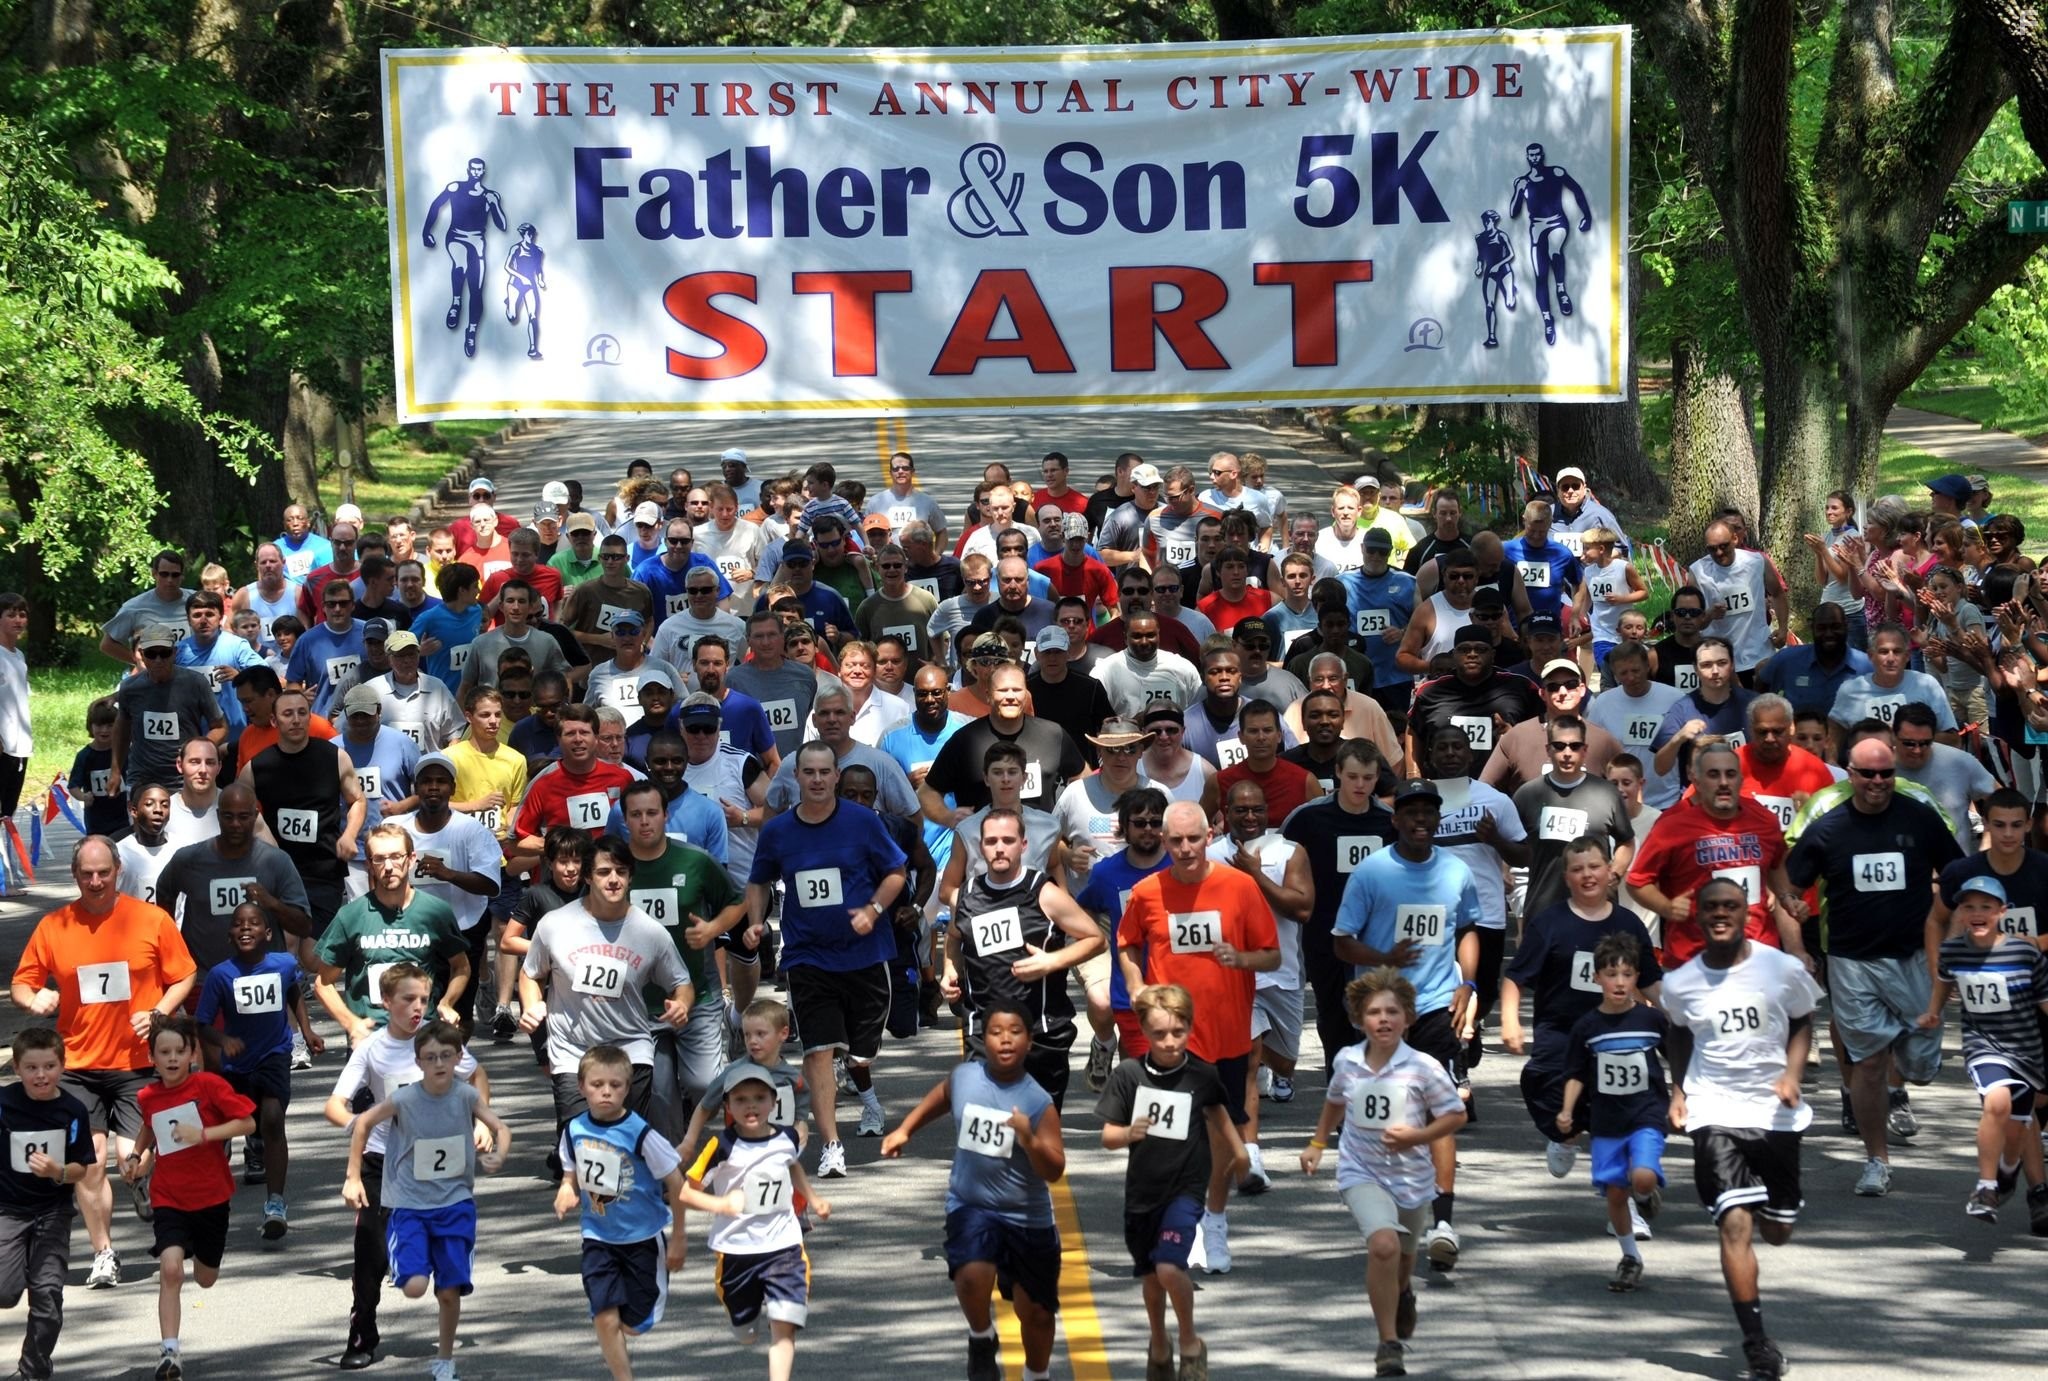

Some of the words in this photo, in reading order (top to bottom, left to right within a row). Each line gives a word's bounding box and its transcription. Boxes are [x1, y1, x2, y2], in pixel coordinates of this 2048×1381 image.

[490, 82, 616, 116] THE
[651, 81, 839, 117] FIRST
[869, 79, 1134, 116] ANNUAL
[1167, 62, 1524, 111] CITY-WIDE
[573, 145, 931, 241] Father
[947, 142, 1028, 238] &
[1043, 141, 1247, 234] Son
[1294, 130, 1451, 229] 5K
[2011, 206, 2025, 228] N
[662, 259, 1374, 380] START
[893, 511, 913, 523] 442
[1170, 546, 1192, 561] 597
[1522, 568, 1546, 583] 254
[1724, 592, 1749, 612] 175
[1360, 616, 1386, 633] 253
[147, 720, 174, 736] 242
[765, 708, 793, 728] 182
[1628, 721, 1657, 741] 467
[579, 802, 603, 824] 76
[281, 816, 311, 838] 264
[1696, 843, 1762, 865] GIANTS
[1861, 861, 1896, 883] 463
[806, 879, 830, 901] 39
[642, 898, 666, 920] 78
[979, 919, 1011, 949] 207
[1175, 922, 1213, 947] 261
[1402, 913, 1438, 937] 460
[360, 933, 432, 950] MASADA
[98, 972, 110, 996] 7
[581, 964, 619, 990] 120
[240, 983, 277, 1008] 504
[1966, 982, 2001, 1005] 473
[1718, 1005, 1760, 1033] 258
[1604, 1063, 1641, 1088] 533
[1147, 1101, 1174, 1129] 84
[1364, 1094, 1391, 1121] 83
[967, 1116, 1005, 1148] 435
[432, 1148, 446, 1173] 2
[583, 1158, 605, 1188] 72
[758, 1179, 783, 1207] 77
